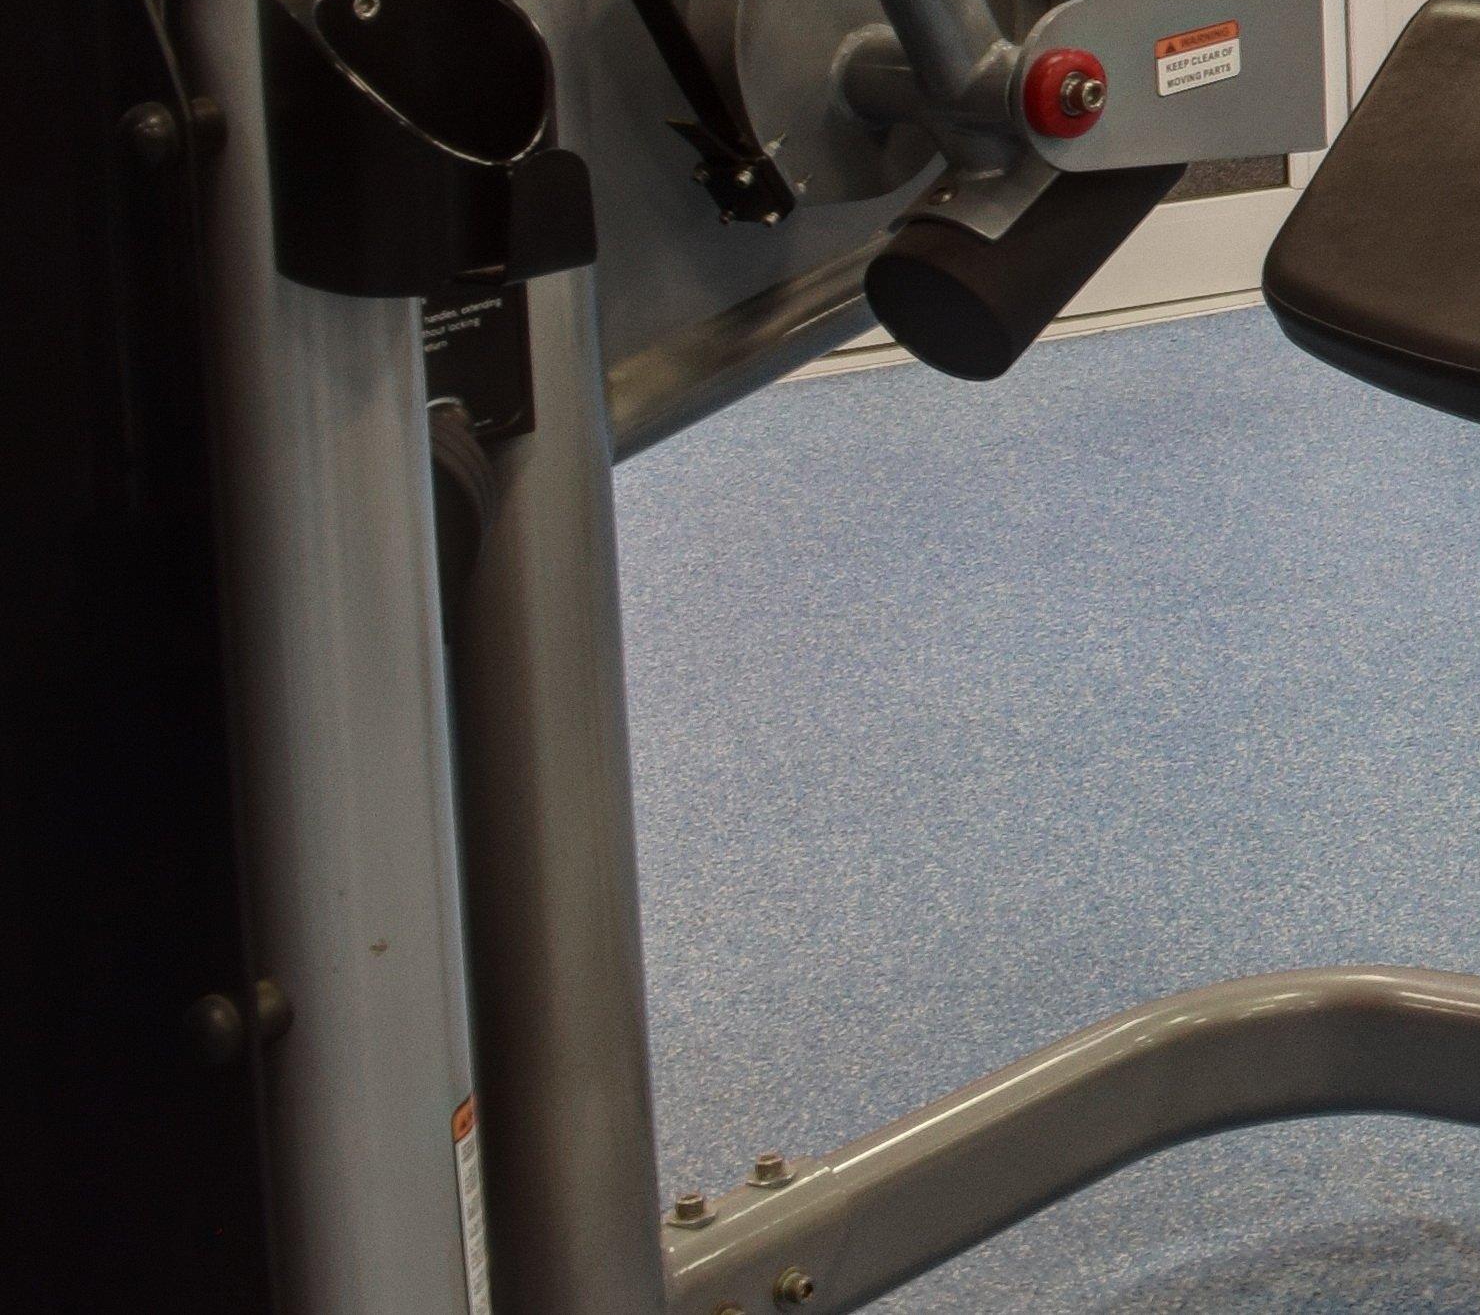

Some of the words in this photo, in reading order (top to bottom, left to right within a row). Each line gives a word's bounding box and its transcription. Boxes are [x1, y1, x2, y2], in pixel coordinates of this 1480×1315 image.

[1166, 59, 1190, 73] KEEP
[1191, 52, 1220, 65] CLEAR
[1221, 46, 1233, 57] OF
[1167, 72, 1202, 88] MOVING
[1203, 63, 1232, 78] PARTS
